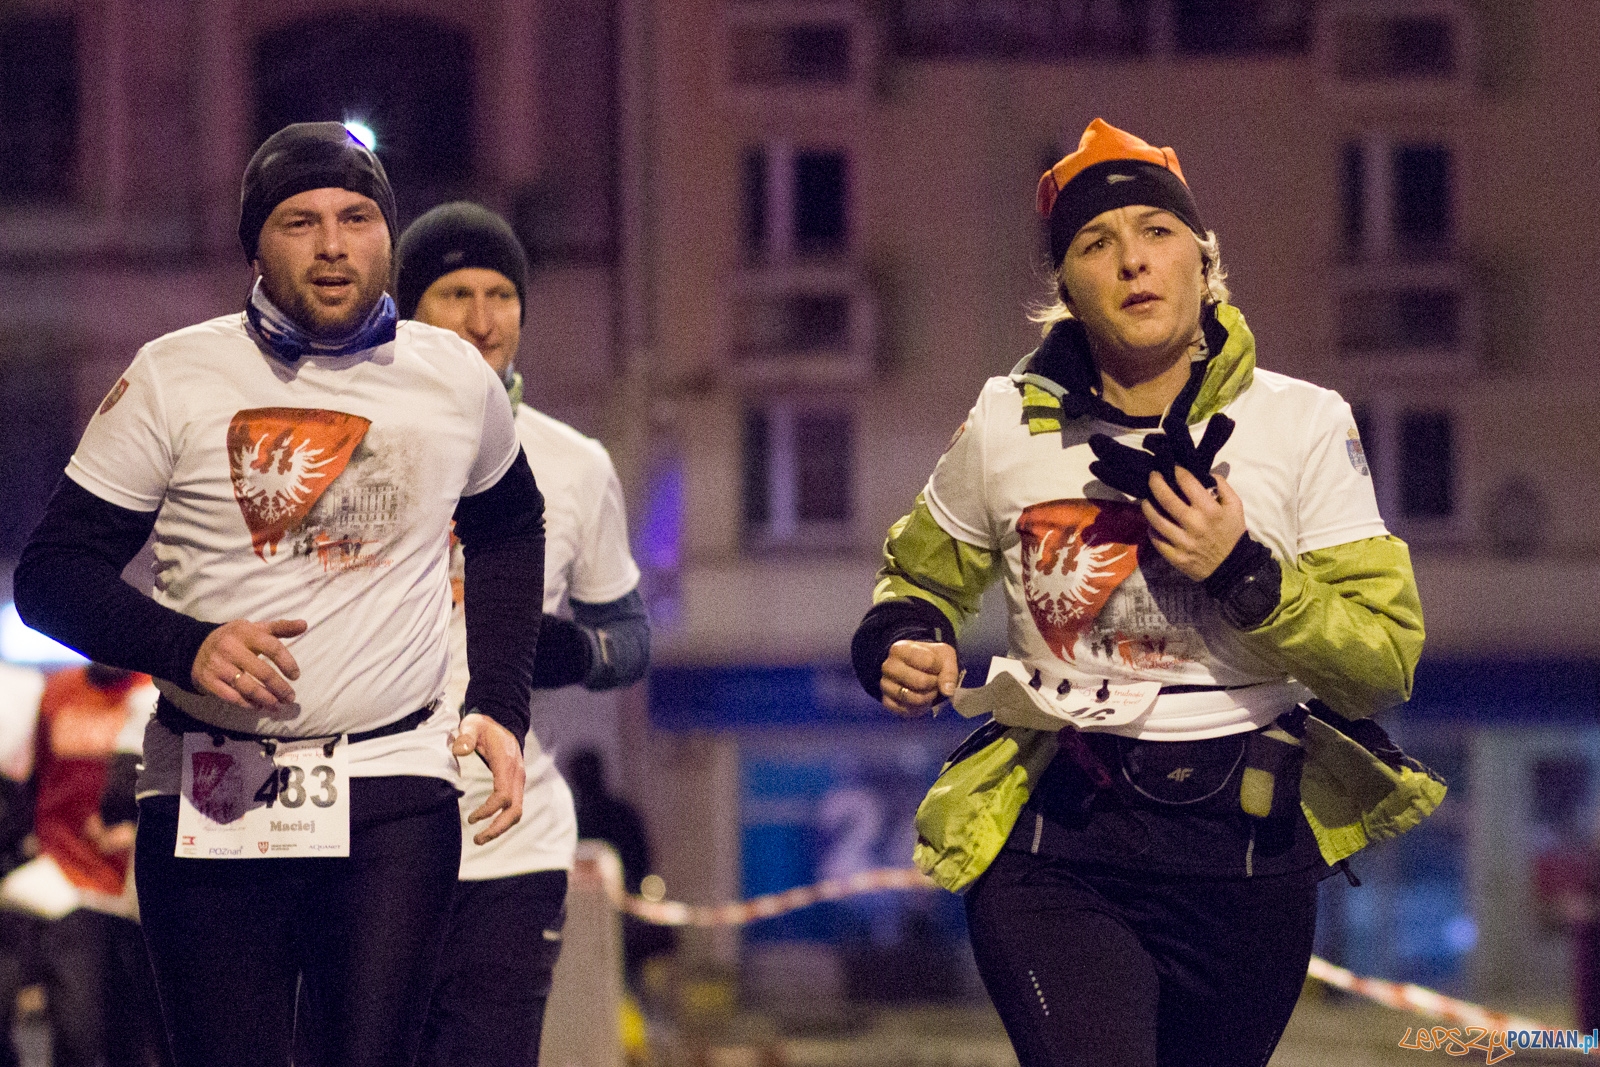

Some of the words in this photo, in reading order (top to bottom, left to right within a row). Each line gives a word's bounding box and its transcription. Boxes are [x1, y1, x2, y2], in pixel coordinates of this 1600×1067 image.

[1167, 767, 1194, 782] 4F
[253, 764, 338, 809] 483
[270, 820, 315, 834] Maciej
